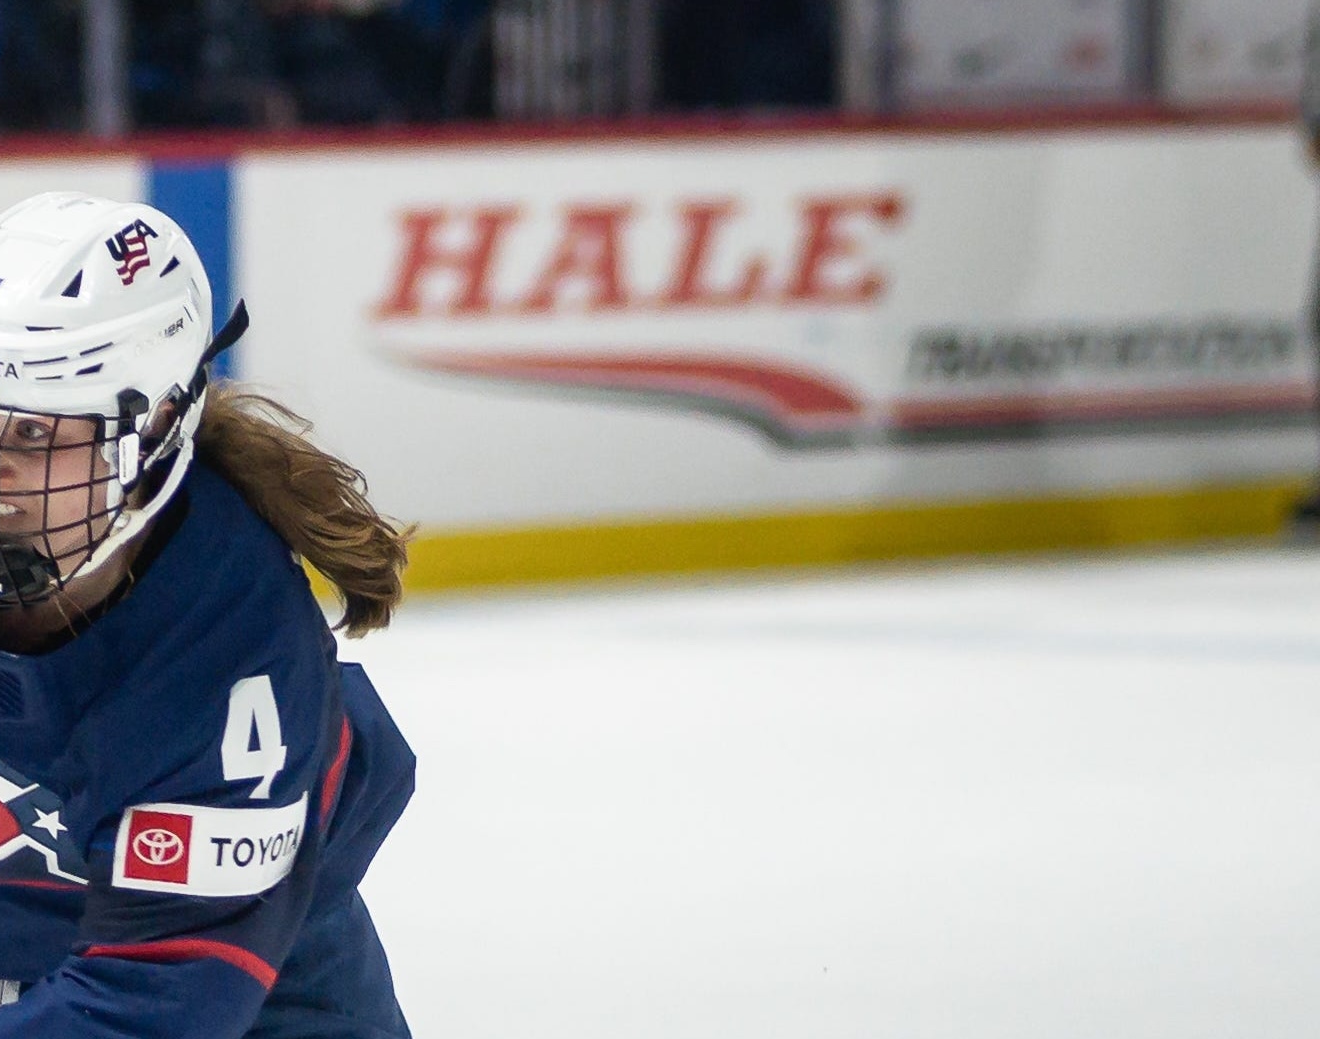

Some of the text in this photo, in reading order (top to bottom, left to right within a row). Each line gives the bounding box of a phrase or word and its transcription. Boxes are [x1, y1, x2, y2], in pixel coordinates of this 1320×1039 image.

[105, 218, 159, 286] USA
[370, 190, 906, 322] HALE
[221, 674, 287, 799] 4
